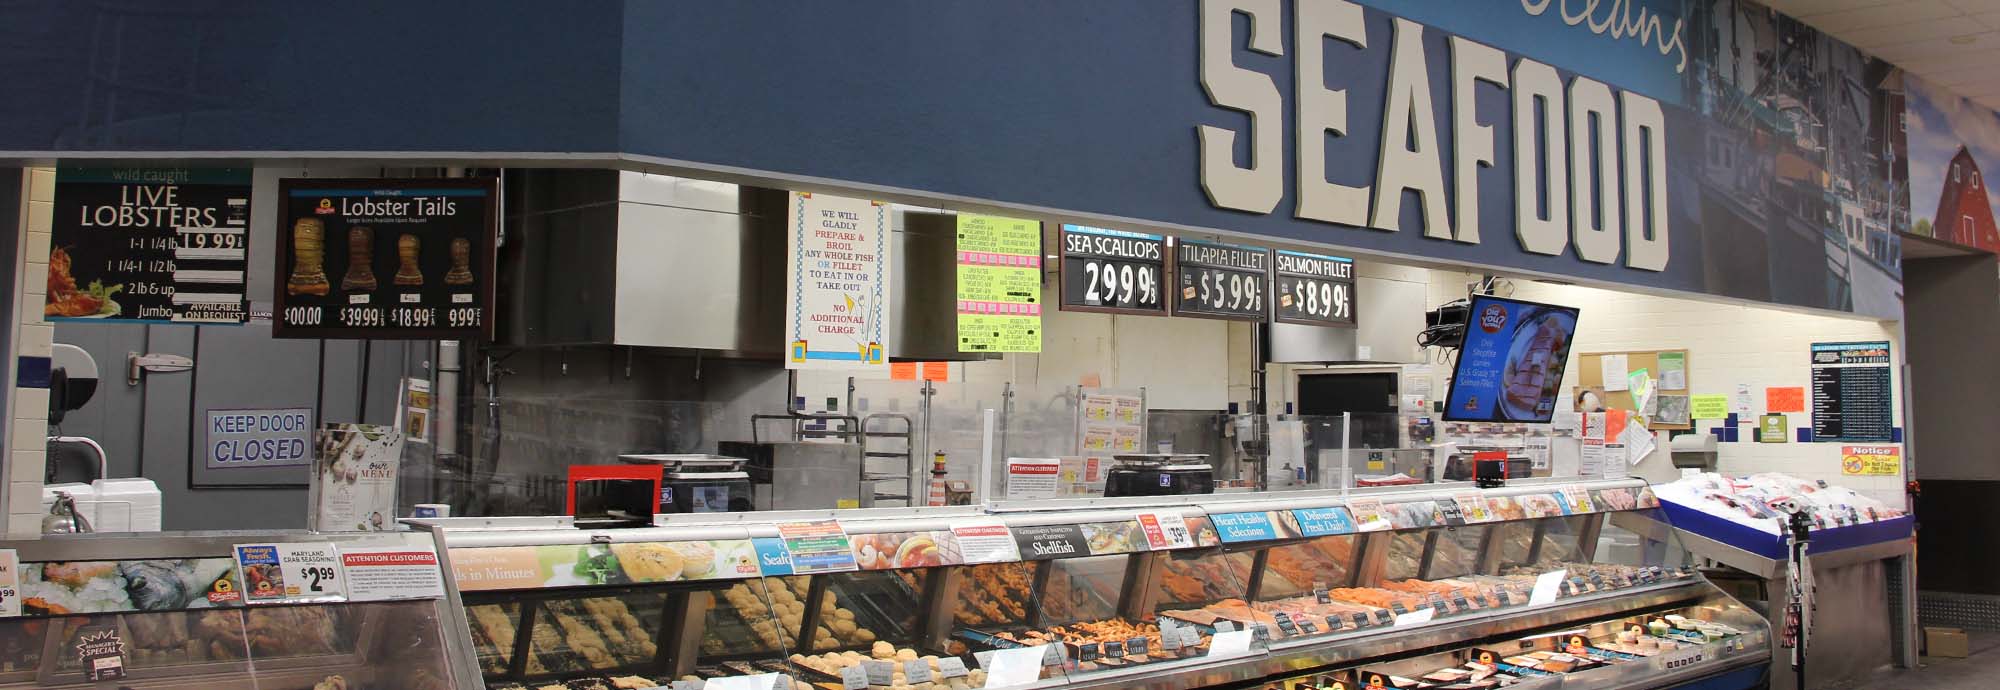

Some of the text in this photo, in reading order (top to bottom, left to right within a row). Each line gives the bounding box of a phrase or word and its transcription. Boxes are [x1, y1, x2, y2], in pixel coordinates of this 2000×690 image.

[1198, 0, 1670, 272] SEAFOOD
[113, 168, 189, 185] wild caught
[122, 185, 179, 207] LIVE
[342, 196, 456, 216] Lobster Tails
[80, 205, 217, 228] LOBSTERS
[821, 209, 859, 220] WE WILL
[822, 220, 857, 230] GLADLY
[815, 230, 856, 241] PREPARE
[151, 237, 166, 251] 1/4
[826, 241, 853, 251] BROIL
[1066, 234, 1092, 254] SEA
[1095, 236, 1160, 260] SCALLOPS
[804, 249, 874, 262] ANY WHOLE FISH
[1182, 244, 1265, 270] TILAPIA FILLET
[167, 260, 176, 272] lb
[817, 260, 863, 271] OR FILLET
[1278, 255, 1352, 279] SALMON FILLET
[809, 269, 869, 281] TO EAT IN OR
[816, 281, 861, 291] TAKE OUT
[1085, 262, 1150, 304] 29.99
[128, 283, 136, 294] 2
[138, 282, 147, 295] lb
[161, 286, 175, 298] up
[1201, 271, 1255, 311] $5.99
[1296, 280, 1344, 318] $8.99
[137, 304, 173, 319] Jumbo
[191, 303, 242, 312] AVAILABLE
[833, 304, 846, 312] NO
[185, 311, 200, 320] ON
[203, 311, 247, 321] REQUEST
[340, 307, 378, 326] $39.99
[391, 307, 429, 327] $18.99
[809, 314, 864, 324] ADDITIONAL
[817, 325, 856, 334] CHARGE
[214, 414, 305, 432] KEEP DOOR
[214, 438, 305, 462] CLOSED
[1853, 447, 1890, 455] Notice
[369, 461, 389, 470] our
[361, 469, 393, 479] MENU
[1214, 513, 1268, 527] Heart Healthy
[1303, 508, 1338, 520] Delivered
[1304, 519, 1346, 533] Fresh Daily!
[1229, 528, 1265, 538] Selections
[1032, 540, 1076, 556] Shellfish
[346, 554, 435, 563] ATTENTION CUSTOMERS
[763, 552, 792, 566] Seafo
[470, 568, 481, 580] in
[486, 567, 535, 580] Minutes
[86, 646, 117, 656] SPECIAL
